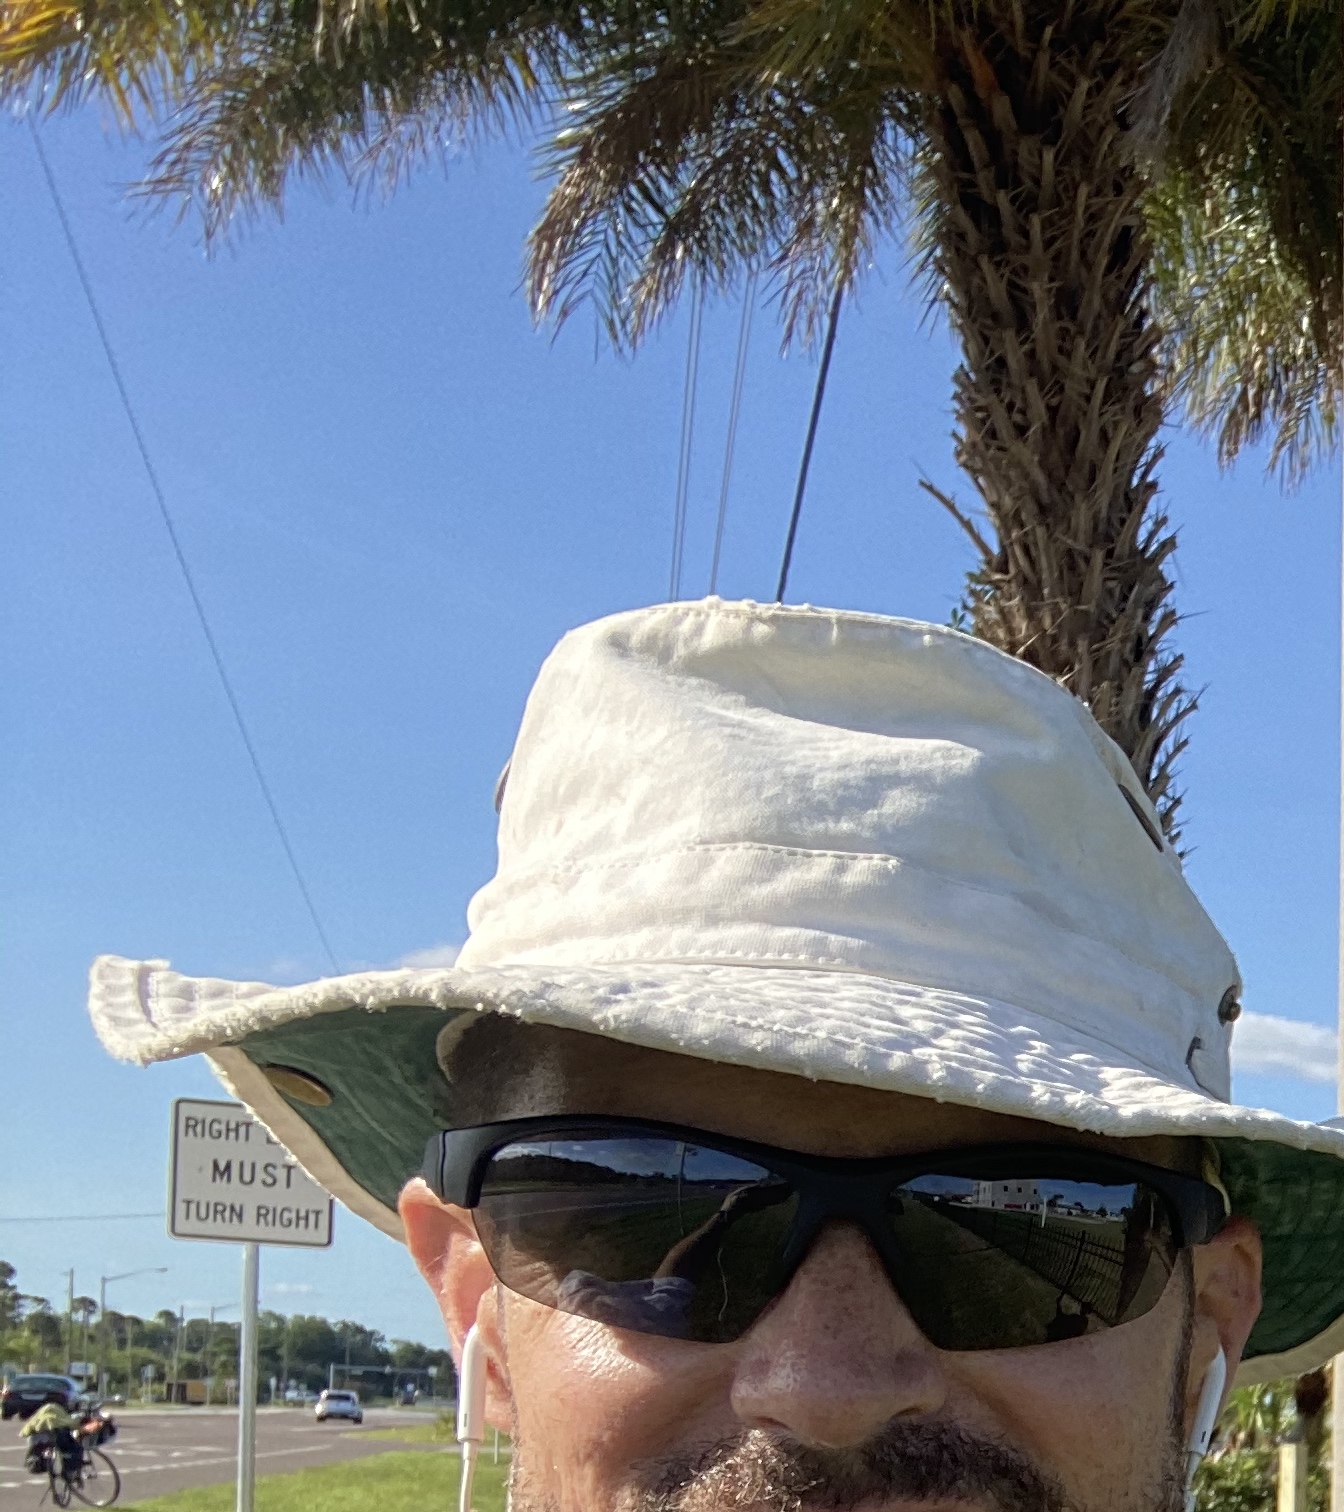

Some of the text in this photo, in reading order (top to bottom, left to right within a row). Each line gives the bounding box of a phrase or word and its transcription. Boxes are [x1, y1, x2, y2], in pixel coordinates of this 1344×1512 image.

[184, 1116, 253, 1142] RIGHT
[211, 1159, 297, 1189] MUST
[182, 1198, 324, 1231] TURN RIGHT
